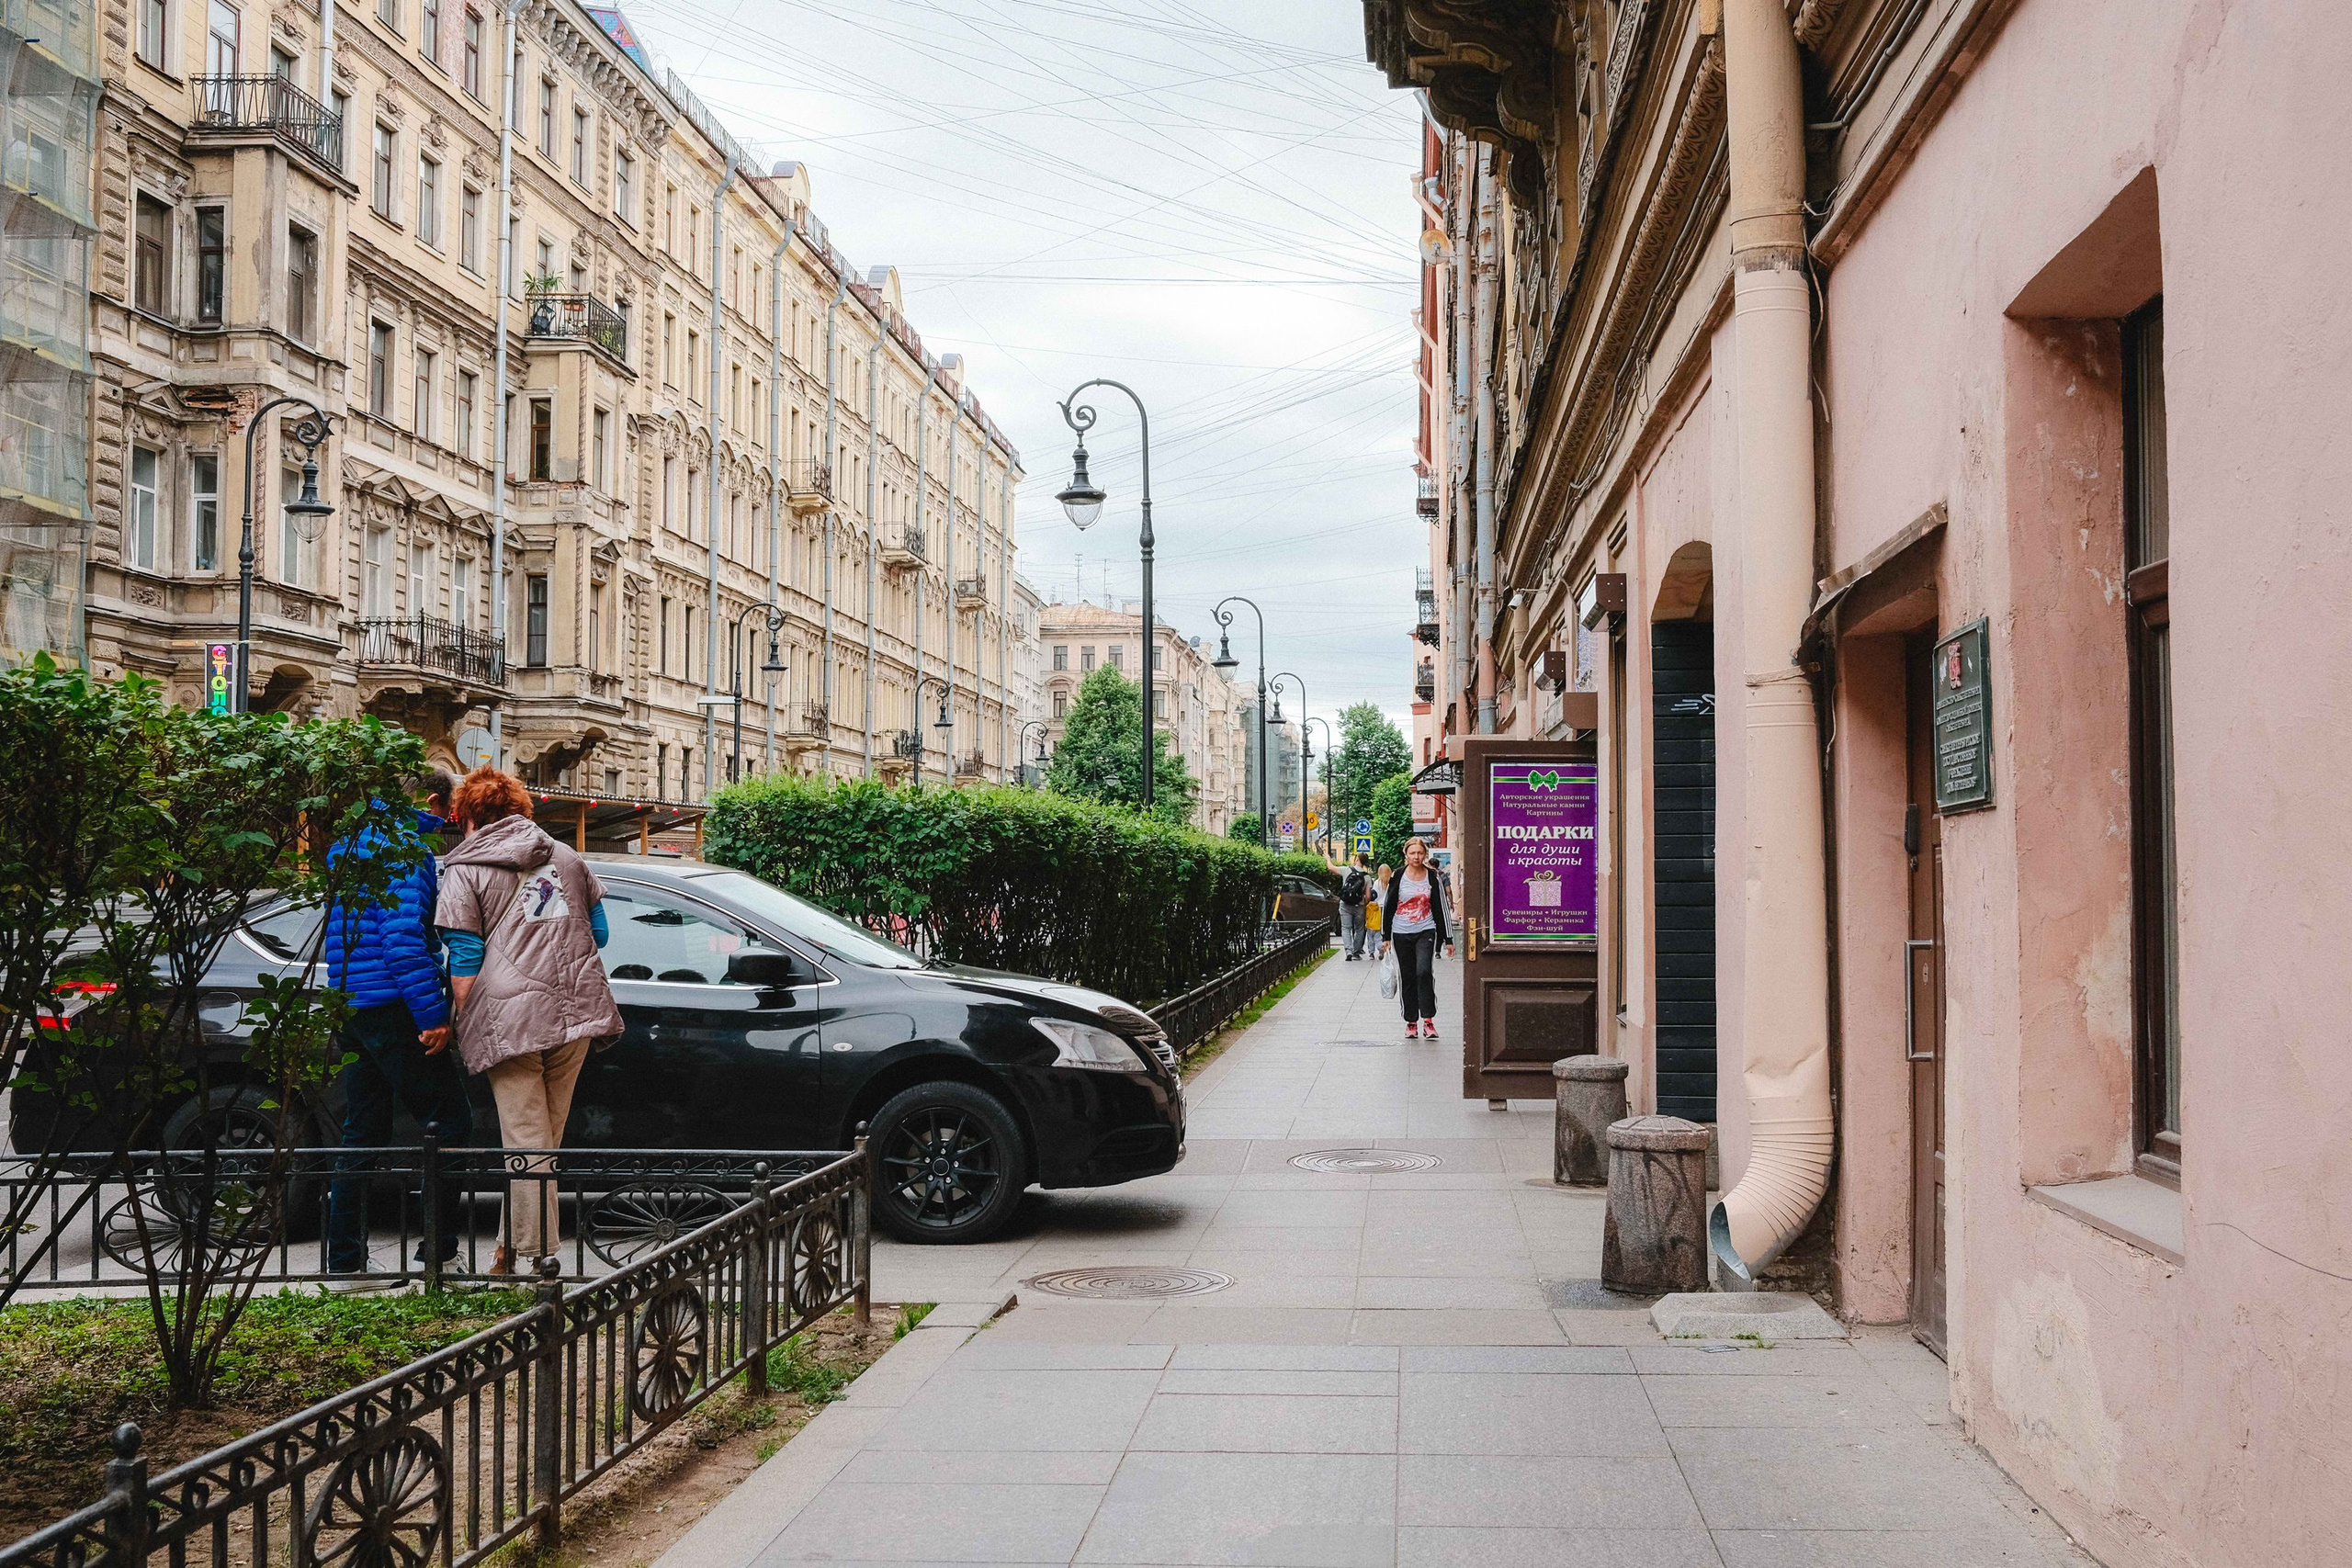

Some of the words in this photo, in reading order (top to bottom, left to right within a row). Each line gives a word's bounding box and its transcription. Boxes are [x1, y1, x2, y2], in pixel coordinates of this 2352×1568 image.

[1497, 826, 1594, 841] ПОДАРКИ
[1510, 843, 1537, 854] для
[1541, 843, 1580, 856] души
[1517, 857, 1582, 867] красоты
[1526, 924, 1564, 932] Фэн-шуй
